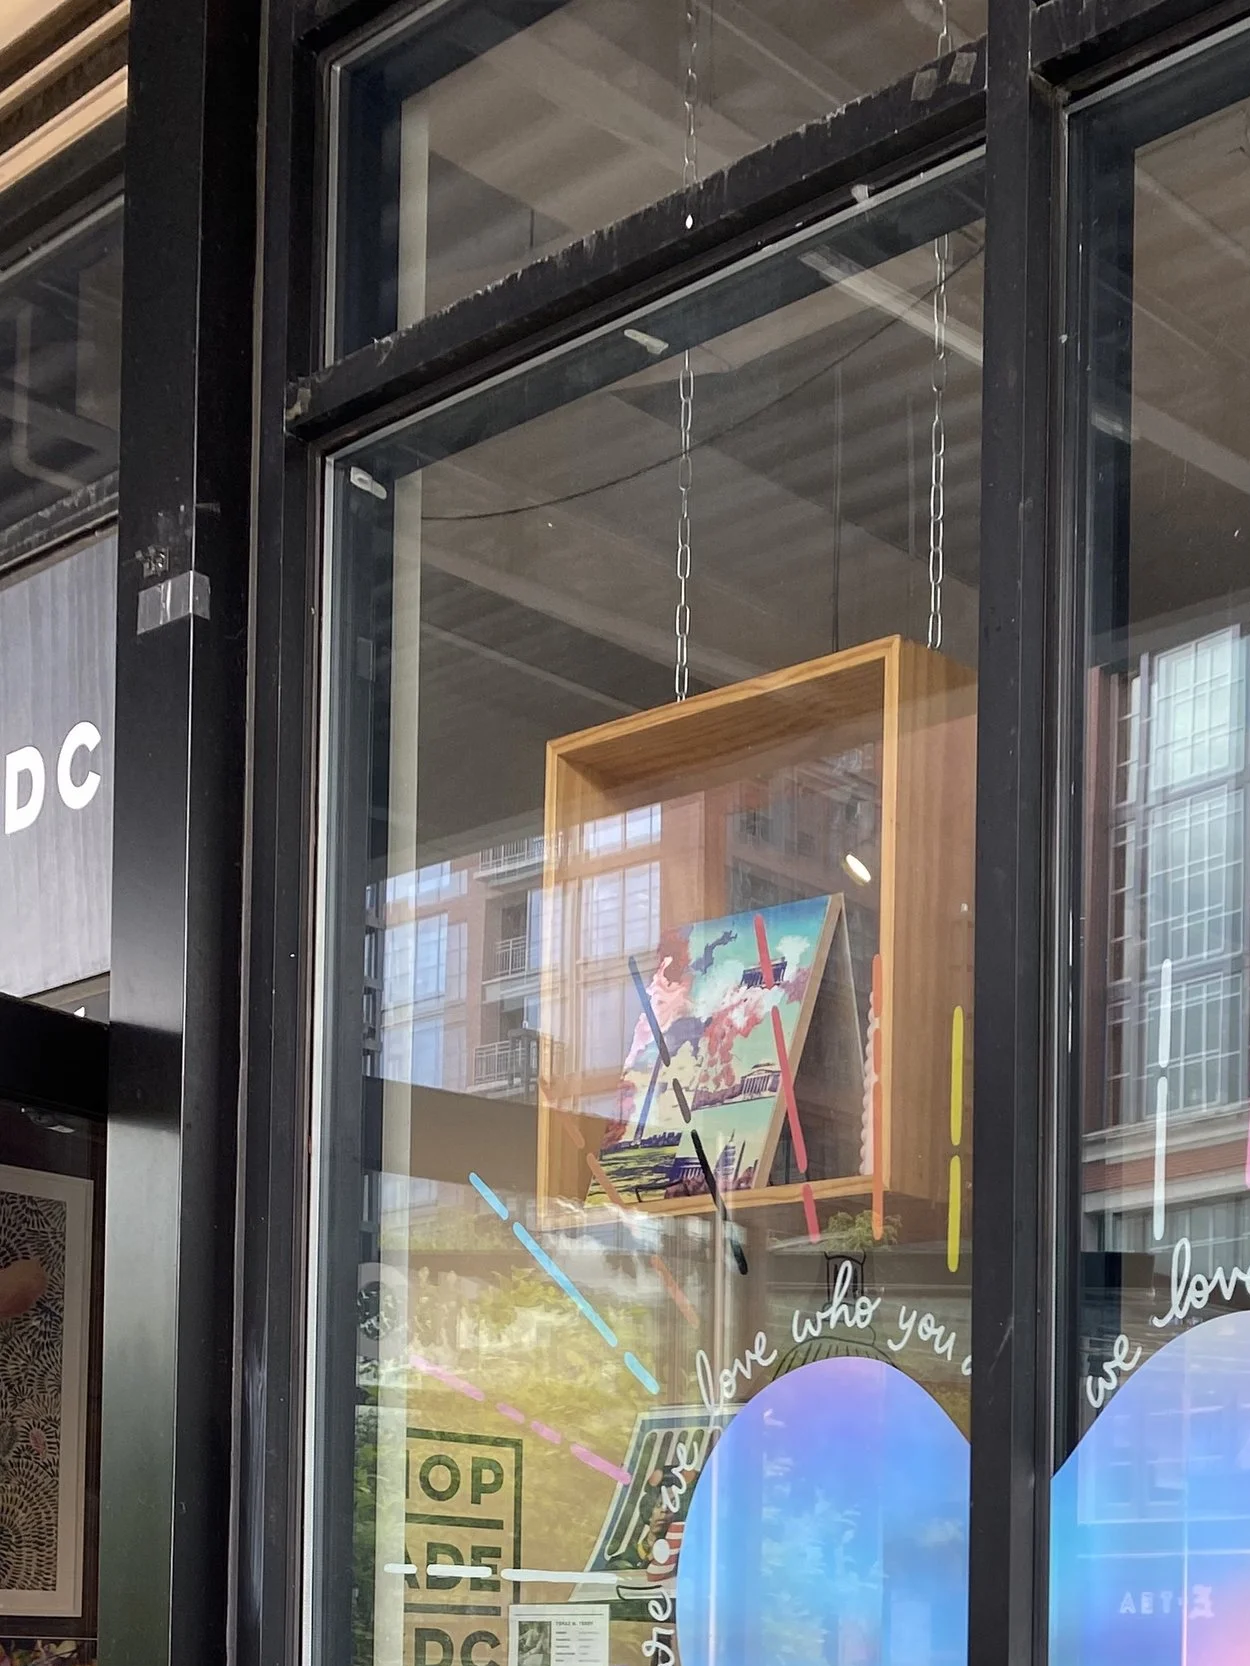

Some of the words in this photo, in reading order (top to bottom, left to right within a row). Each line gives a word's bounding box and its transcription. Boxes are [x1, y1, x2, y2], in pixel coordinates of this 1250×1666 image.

[5, 720, 102, 836] DC
[661, 1440, 699, 1513] we
[696, 1331, 777, 1418] love
[791, 1260, 882, 1343] who
[887, 1305, 957, 1361] you
[1086, 1334, 1143, 1409] we
[404, 1449, 505, 1506] OP
